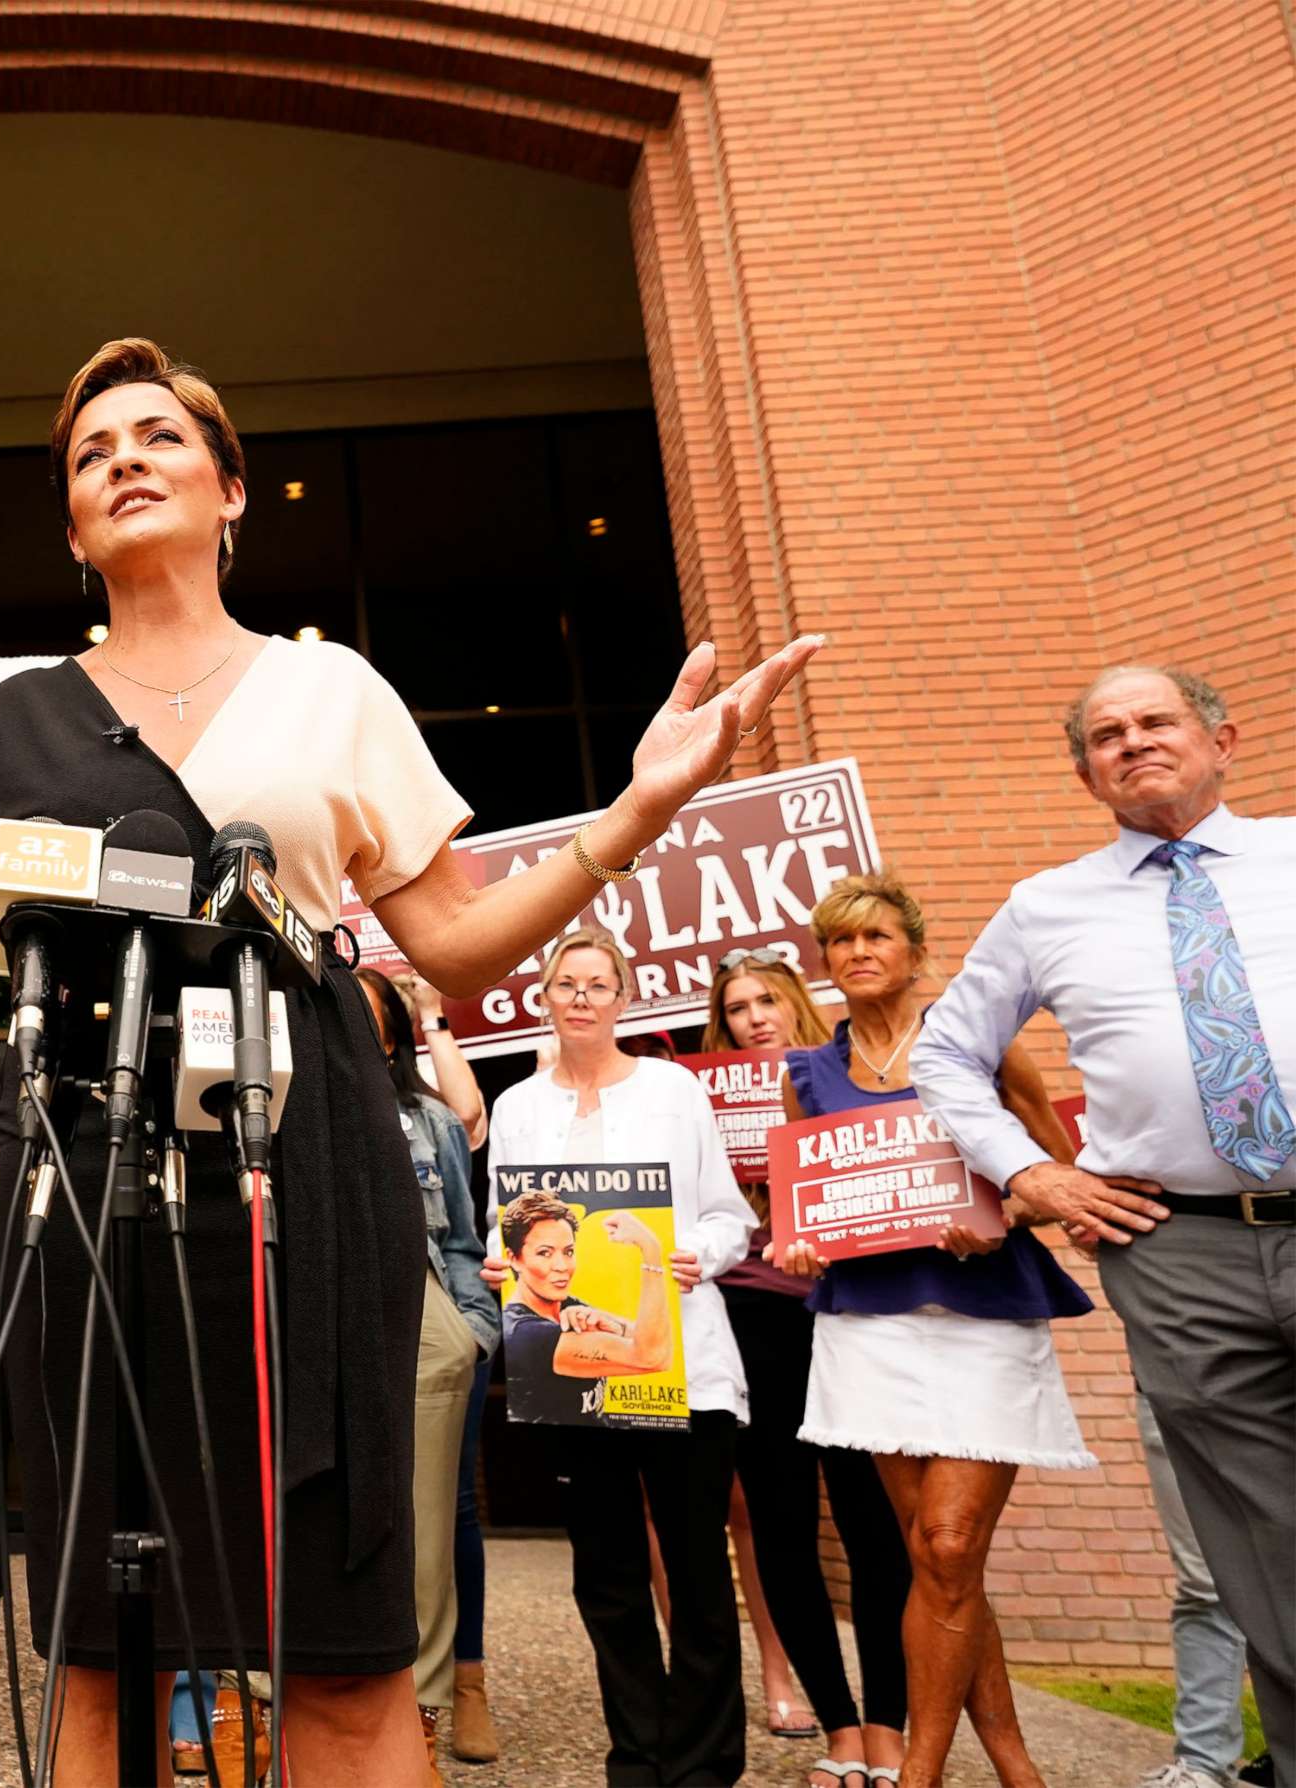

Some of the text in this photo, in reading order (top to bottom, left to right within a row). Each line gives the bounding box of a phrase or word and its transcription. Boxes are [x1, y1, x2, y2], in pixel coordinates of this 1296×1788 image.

[789, 789, 835, 829] 22
[17, 835, 65, 857] az
[251, 869, 280, 915] abc
[635, 829, 850, 952] LAKE
[286, 909, 314, 962] 15
[192, 1034, 234, 1044] VOIC
[698, 1062, 752, 1096] KARI
[797, 1122, 866, 1168] KARI
[831, 1146, 917, 1169] GOVERNOR
[499, 1169, 668, 1193] WE CAN DO IT!
[822, 1167, 936, 1203] ENDORSED BY
[805, 1183, 961, 1225] PRESIDENT TRUMP
[817, 1228, 847, 1243] TEXT
[892, 1219, 911, 1231] TO
[610, 1385, 686, 1405] KARI LAKE
[622, 1403, 672, 1412] GOVERNOR
